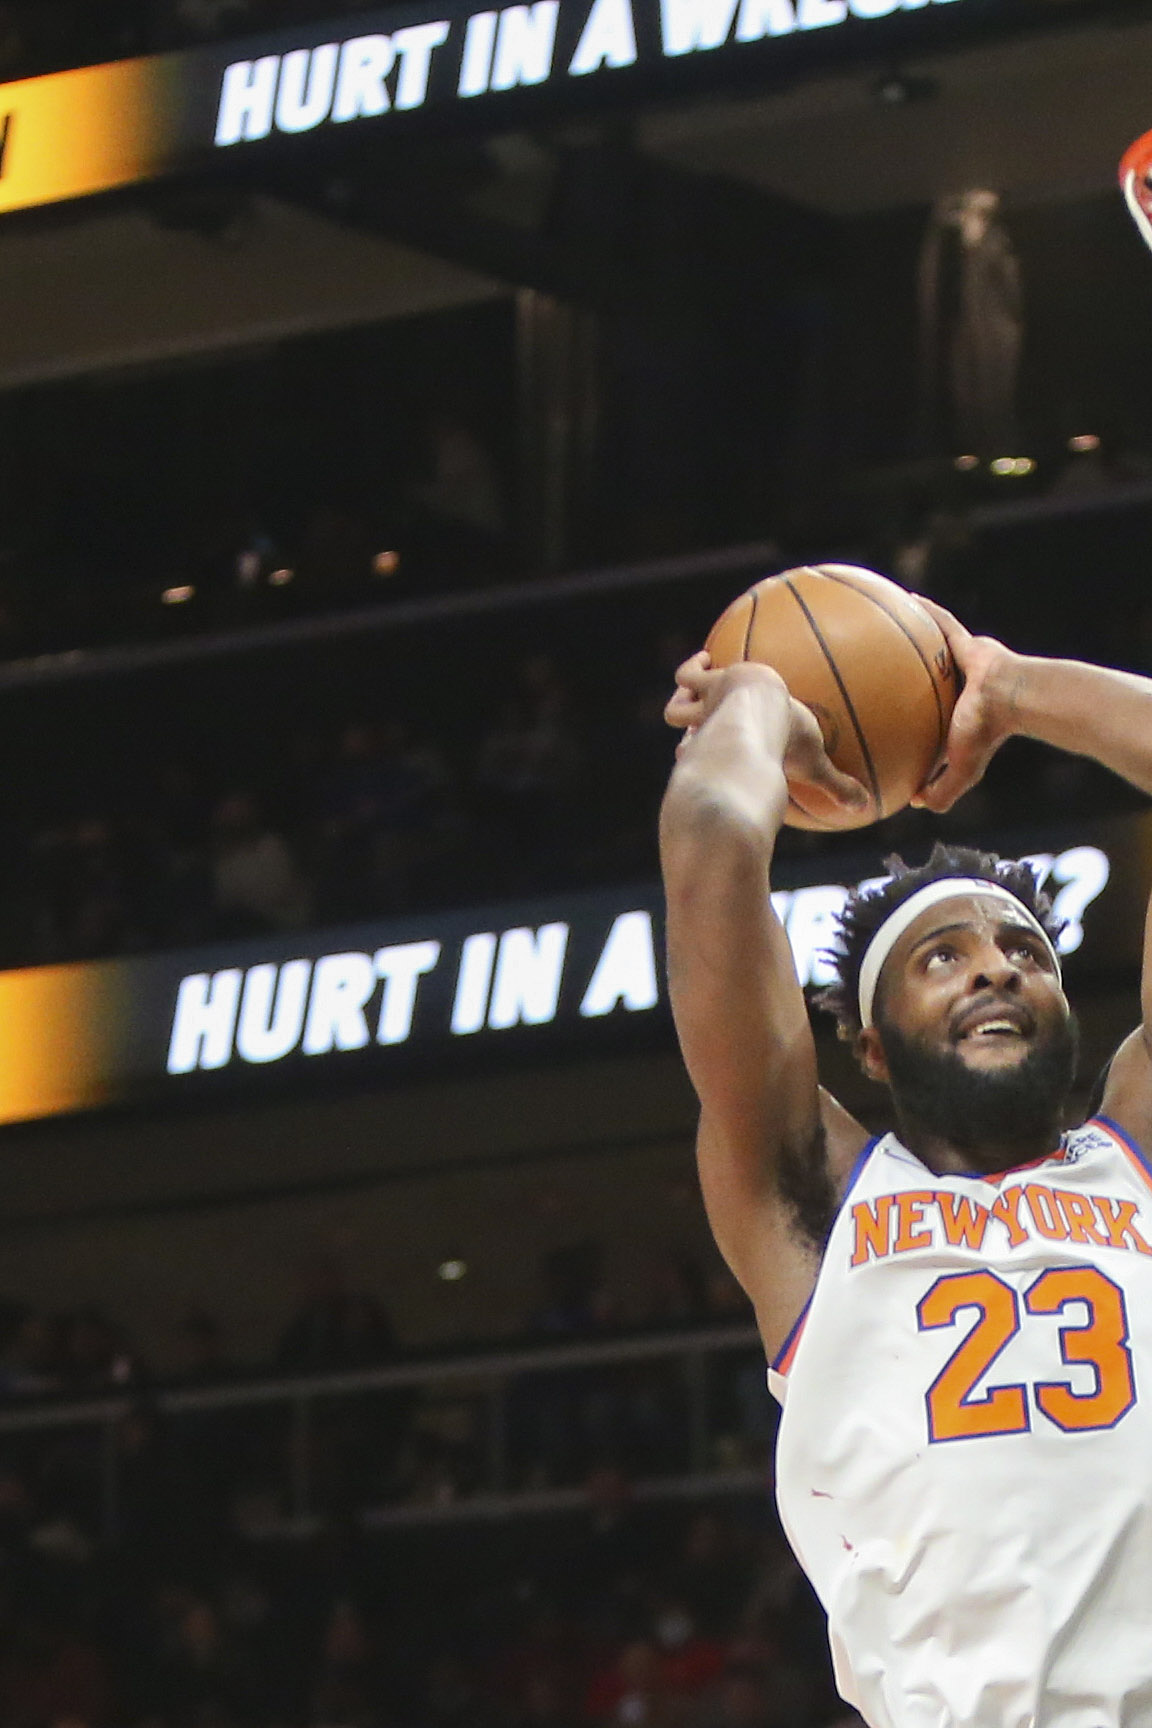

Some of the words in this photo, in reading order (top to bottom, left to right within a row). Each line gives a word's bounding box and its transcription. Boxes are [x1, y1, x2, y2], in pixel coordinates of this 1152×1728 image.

[214, 20, 452, 147] HURT
[456, 0, 560, 98] IN
[568, 0, 638, 75] A
[167, 940, 441, 1075] HURT
[450, 922, 570, 1035] IN
[580, 910, 660, 1017] A
[851, 1190, 989, 1267] NEW
[916, 1264, 1138, 1444] 23
